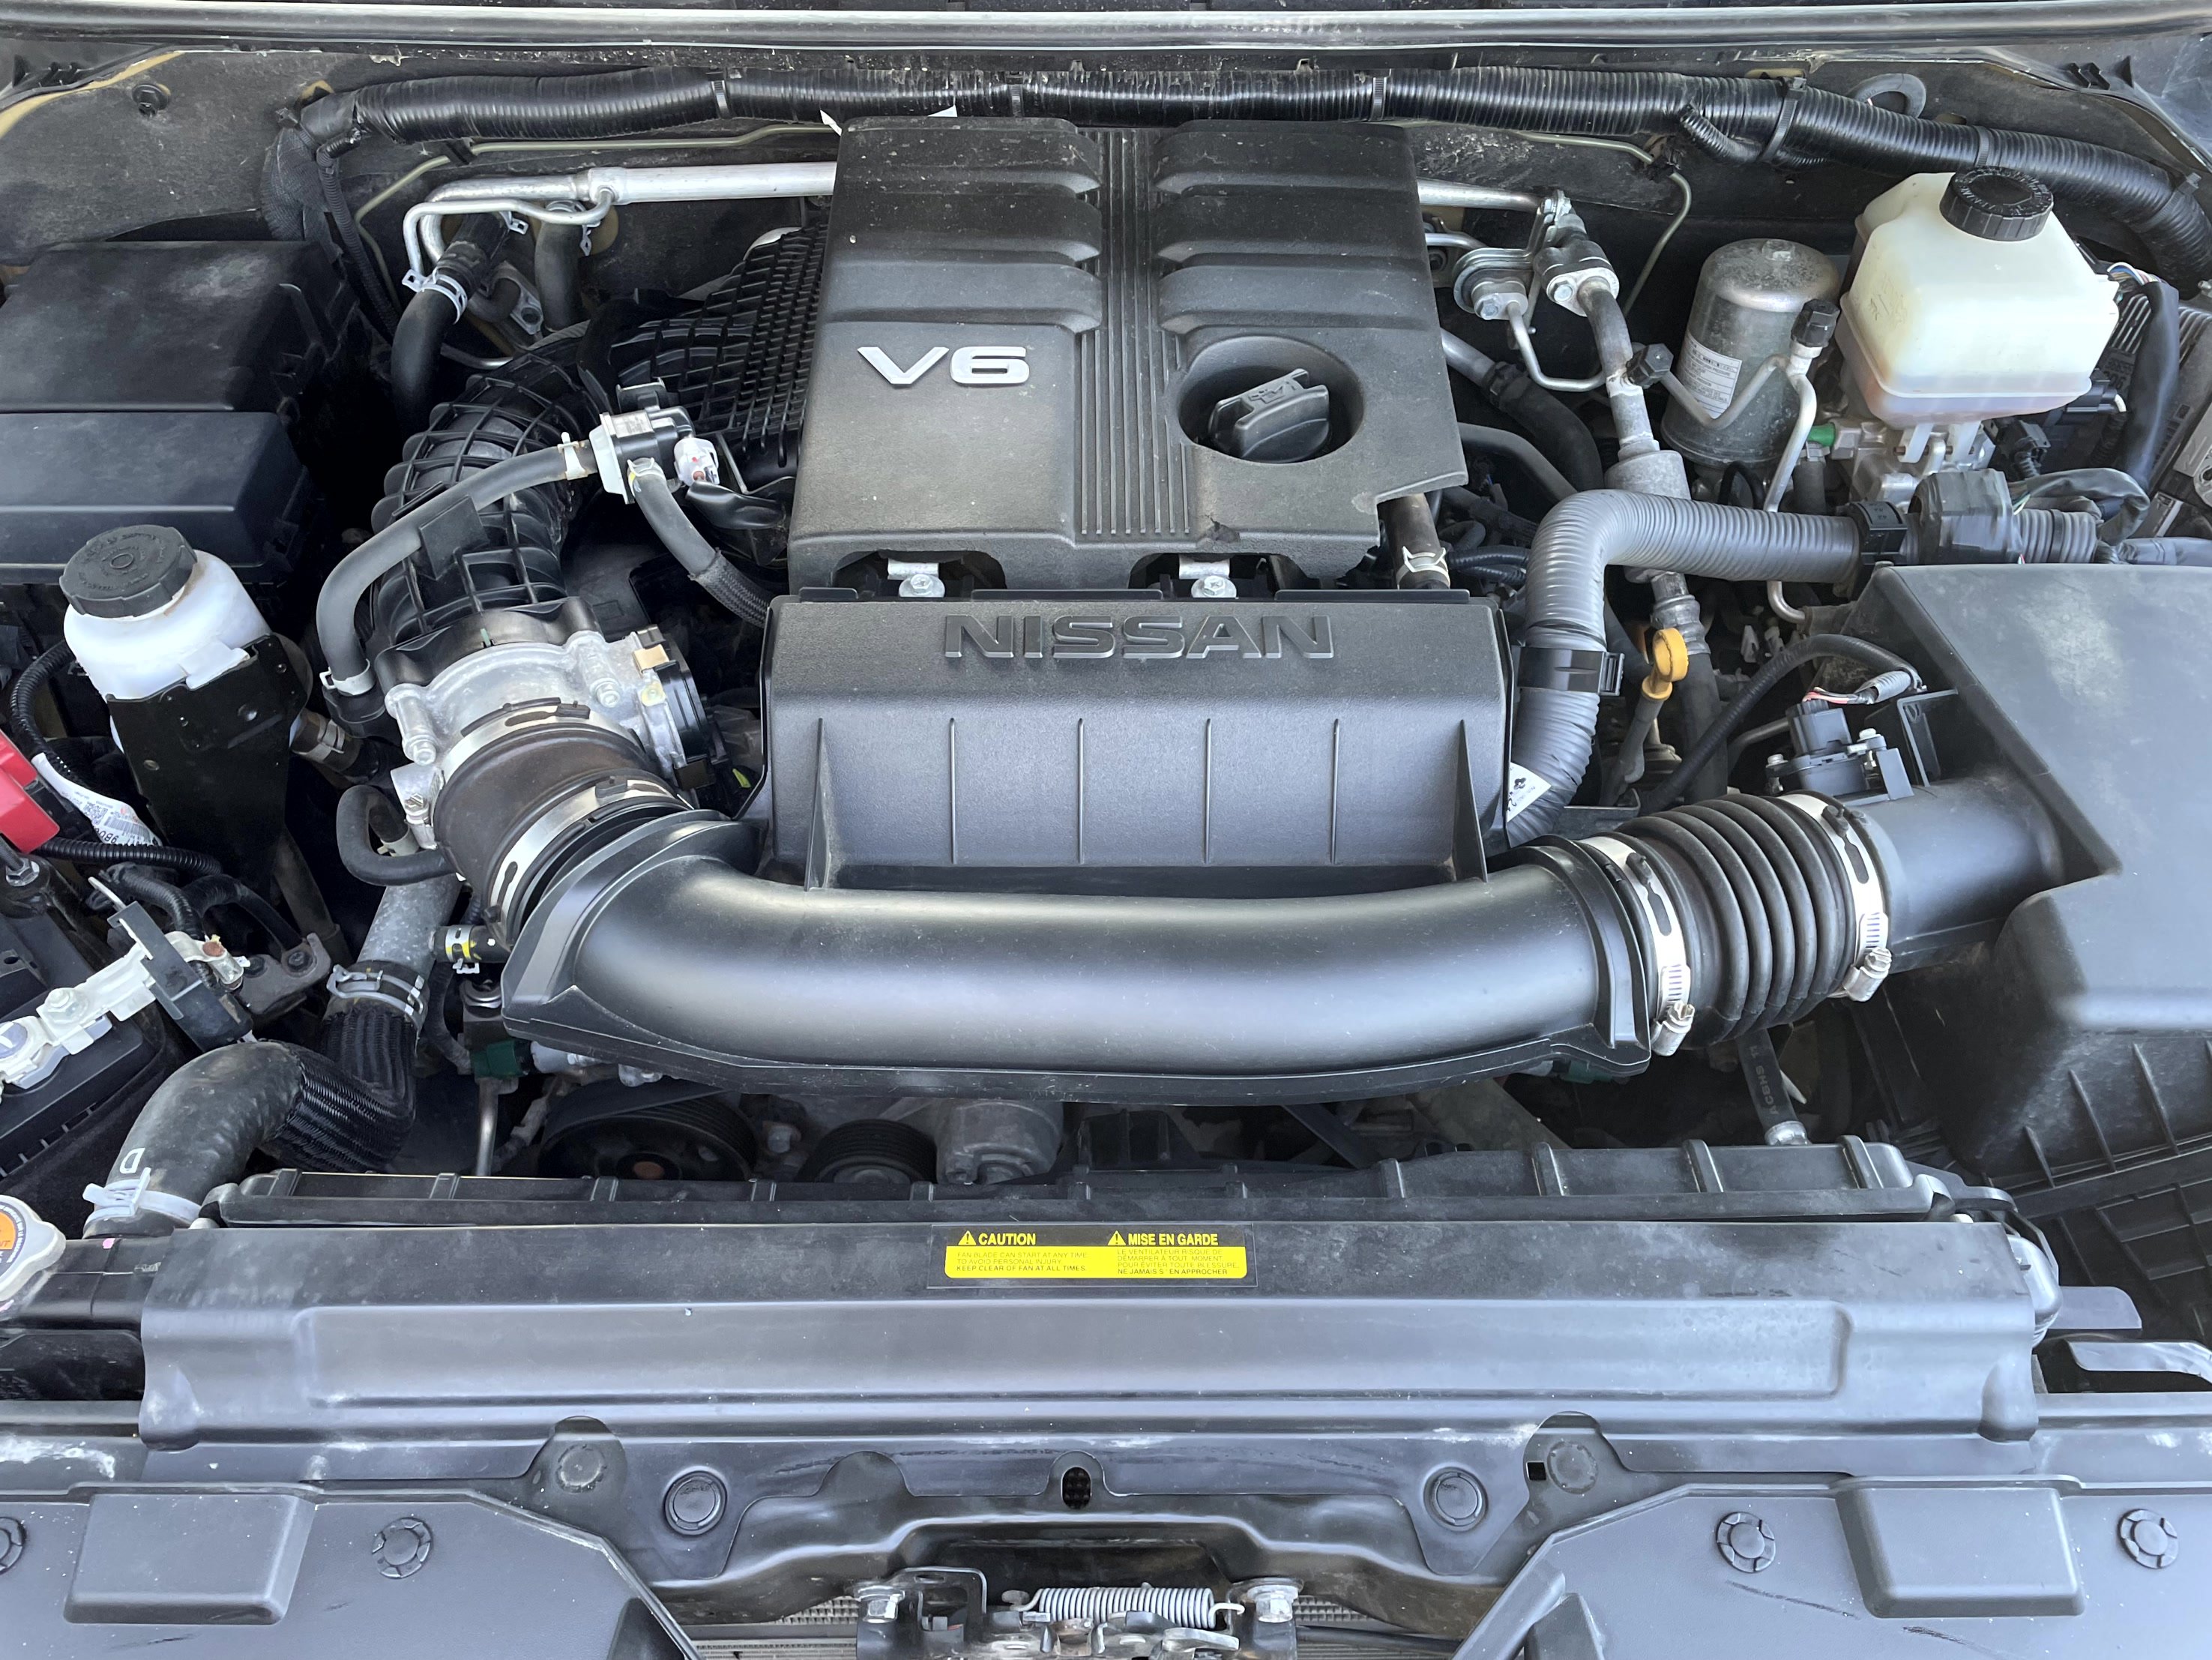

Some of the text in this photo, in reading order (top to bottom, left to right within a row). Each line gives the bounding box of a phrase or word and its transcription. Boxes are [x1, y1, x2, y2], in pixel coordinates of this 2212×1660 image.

[858, 346, 1030, 385] V6
[945, 615, 1334, 658] NISSAN
[978, 1233, 1036, 1245] CAUTION
[1128, 1233, 1219, 1245] MISE EN GARDE
